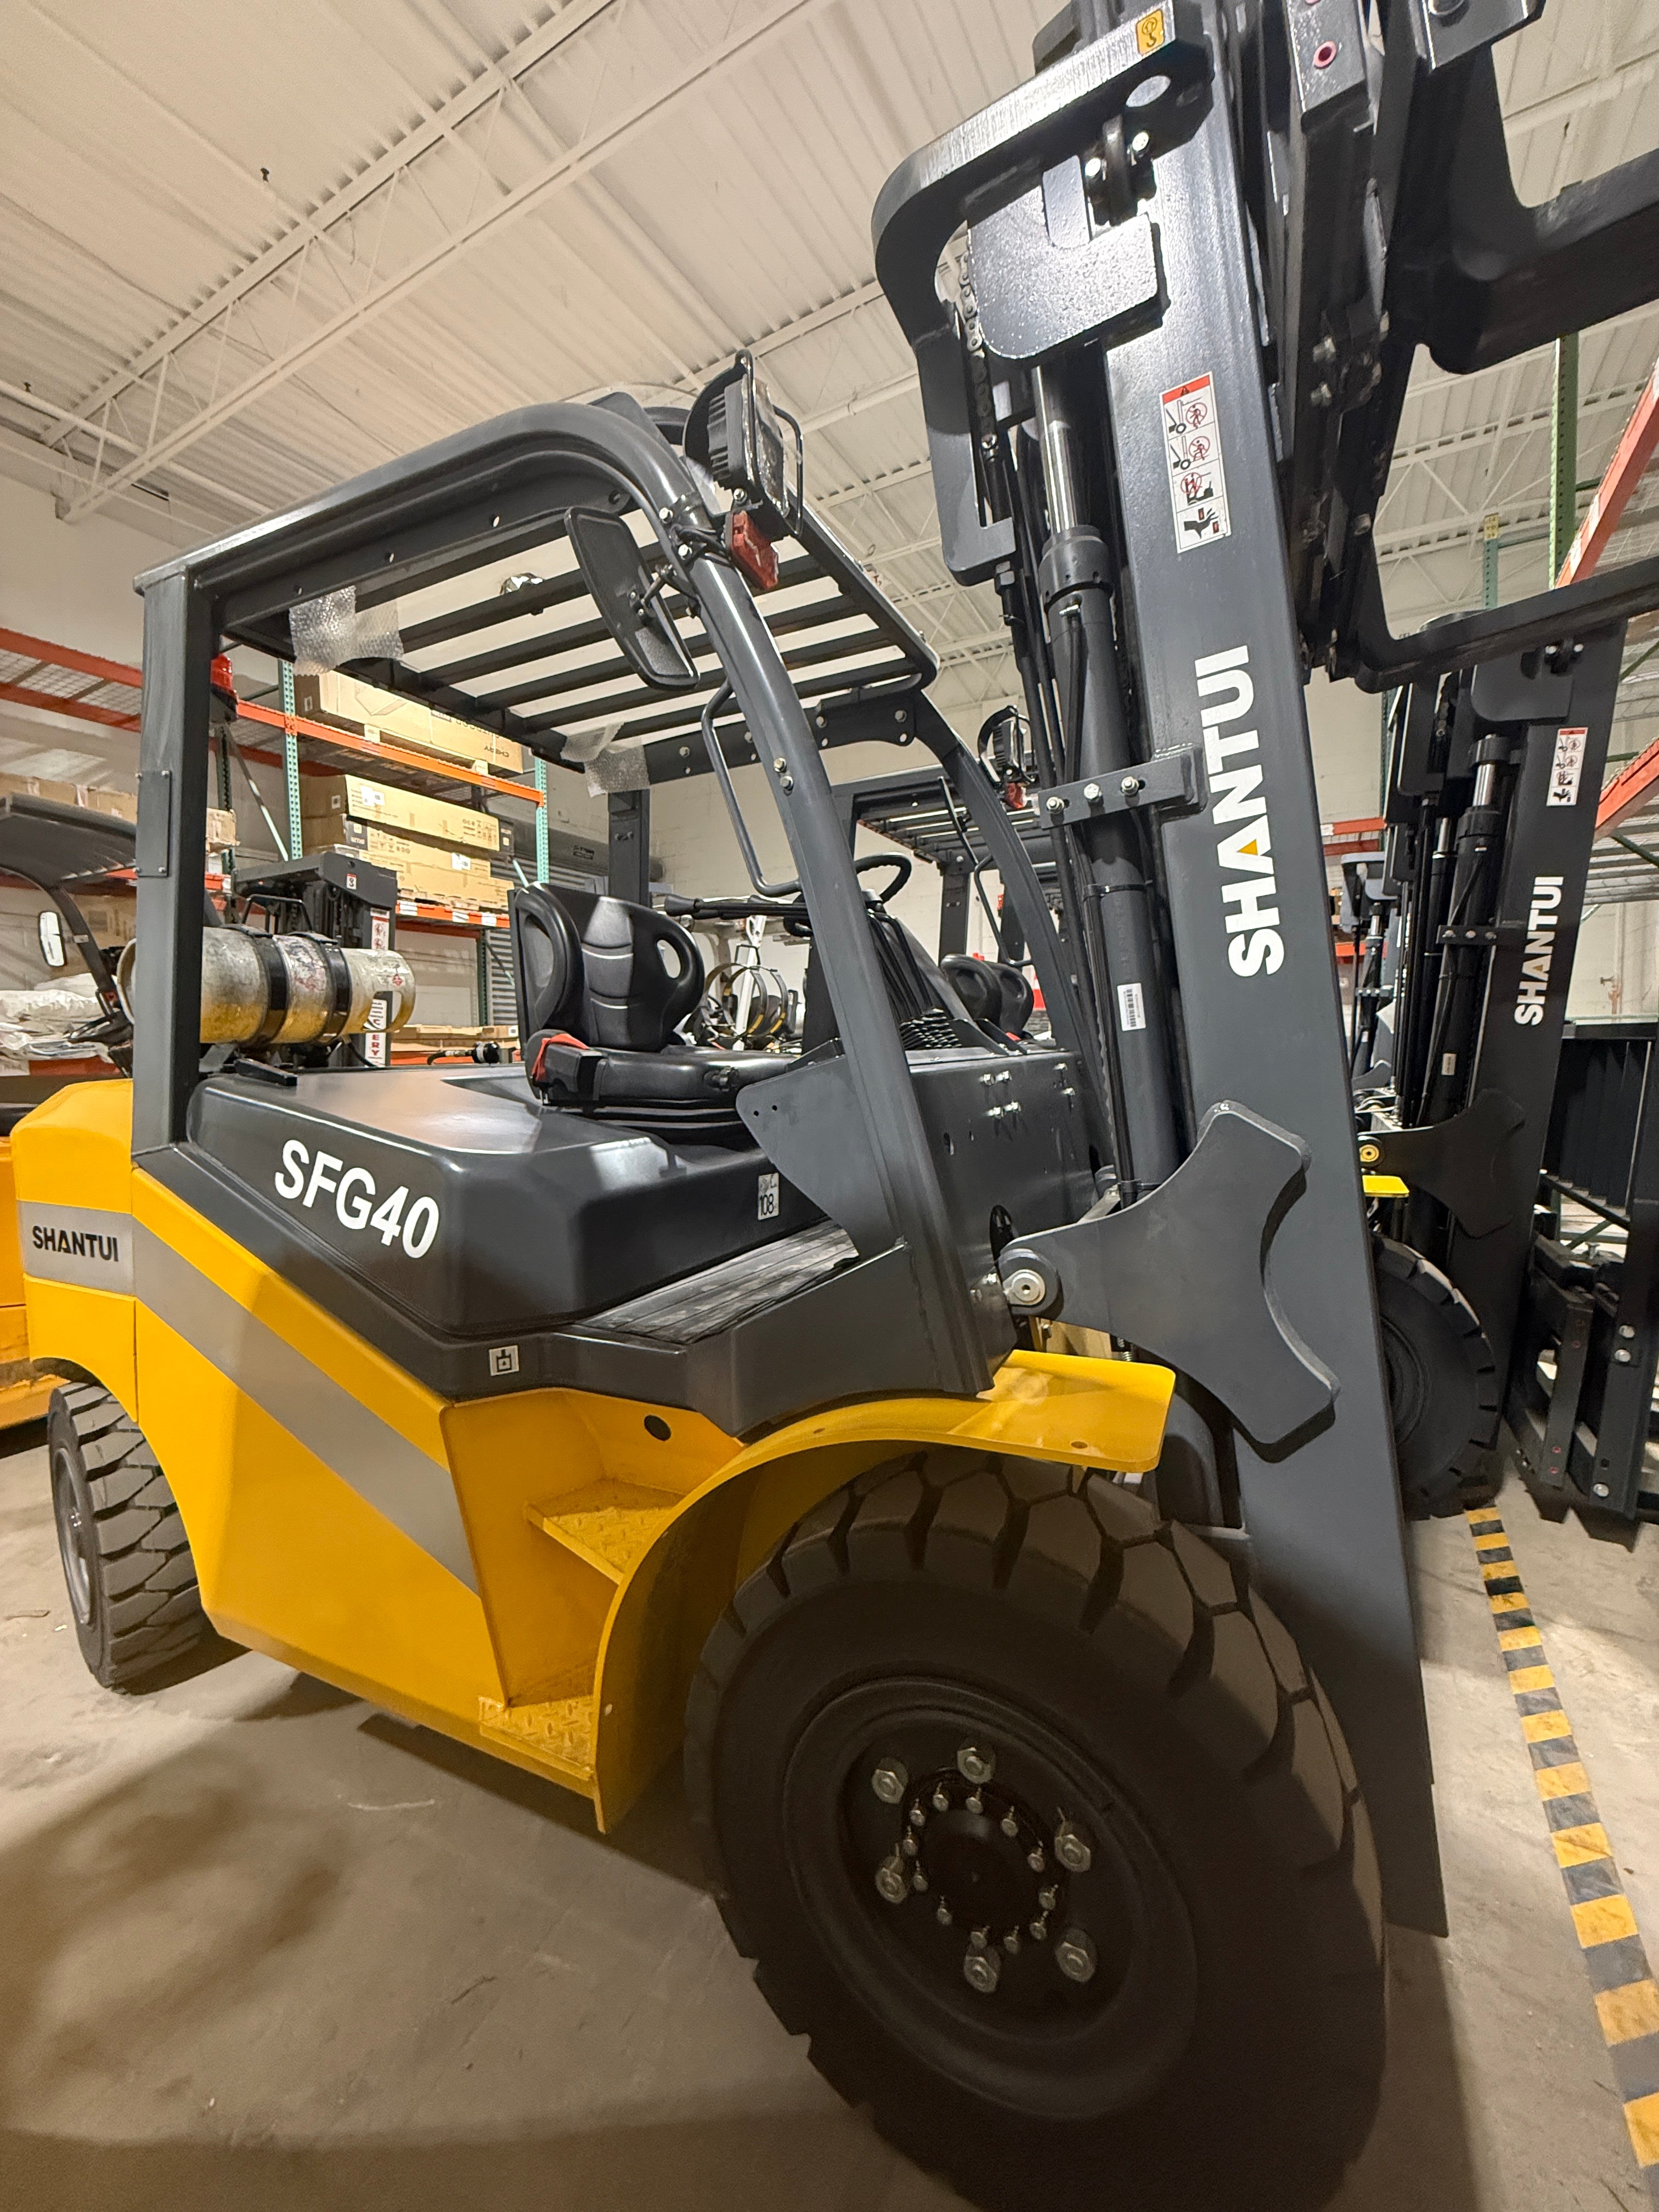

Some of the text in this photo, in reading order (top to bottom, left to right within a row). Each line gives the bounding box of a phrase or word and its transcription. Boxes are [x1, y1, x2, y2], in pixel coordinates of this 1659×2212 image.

[1195, 645, 1284, 977] SHANTUI
[1514, 877, 1564, 1025] SHANTUI
[32, 1226, 119, 1262] SHANTUI
[275, 1139, 439, 1259] SFG40
[759, 1193, 774, 1216] 108
